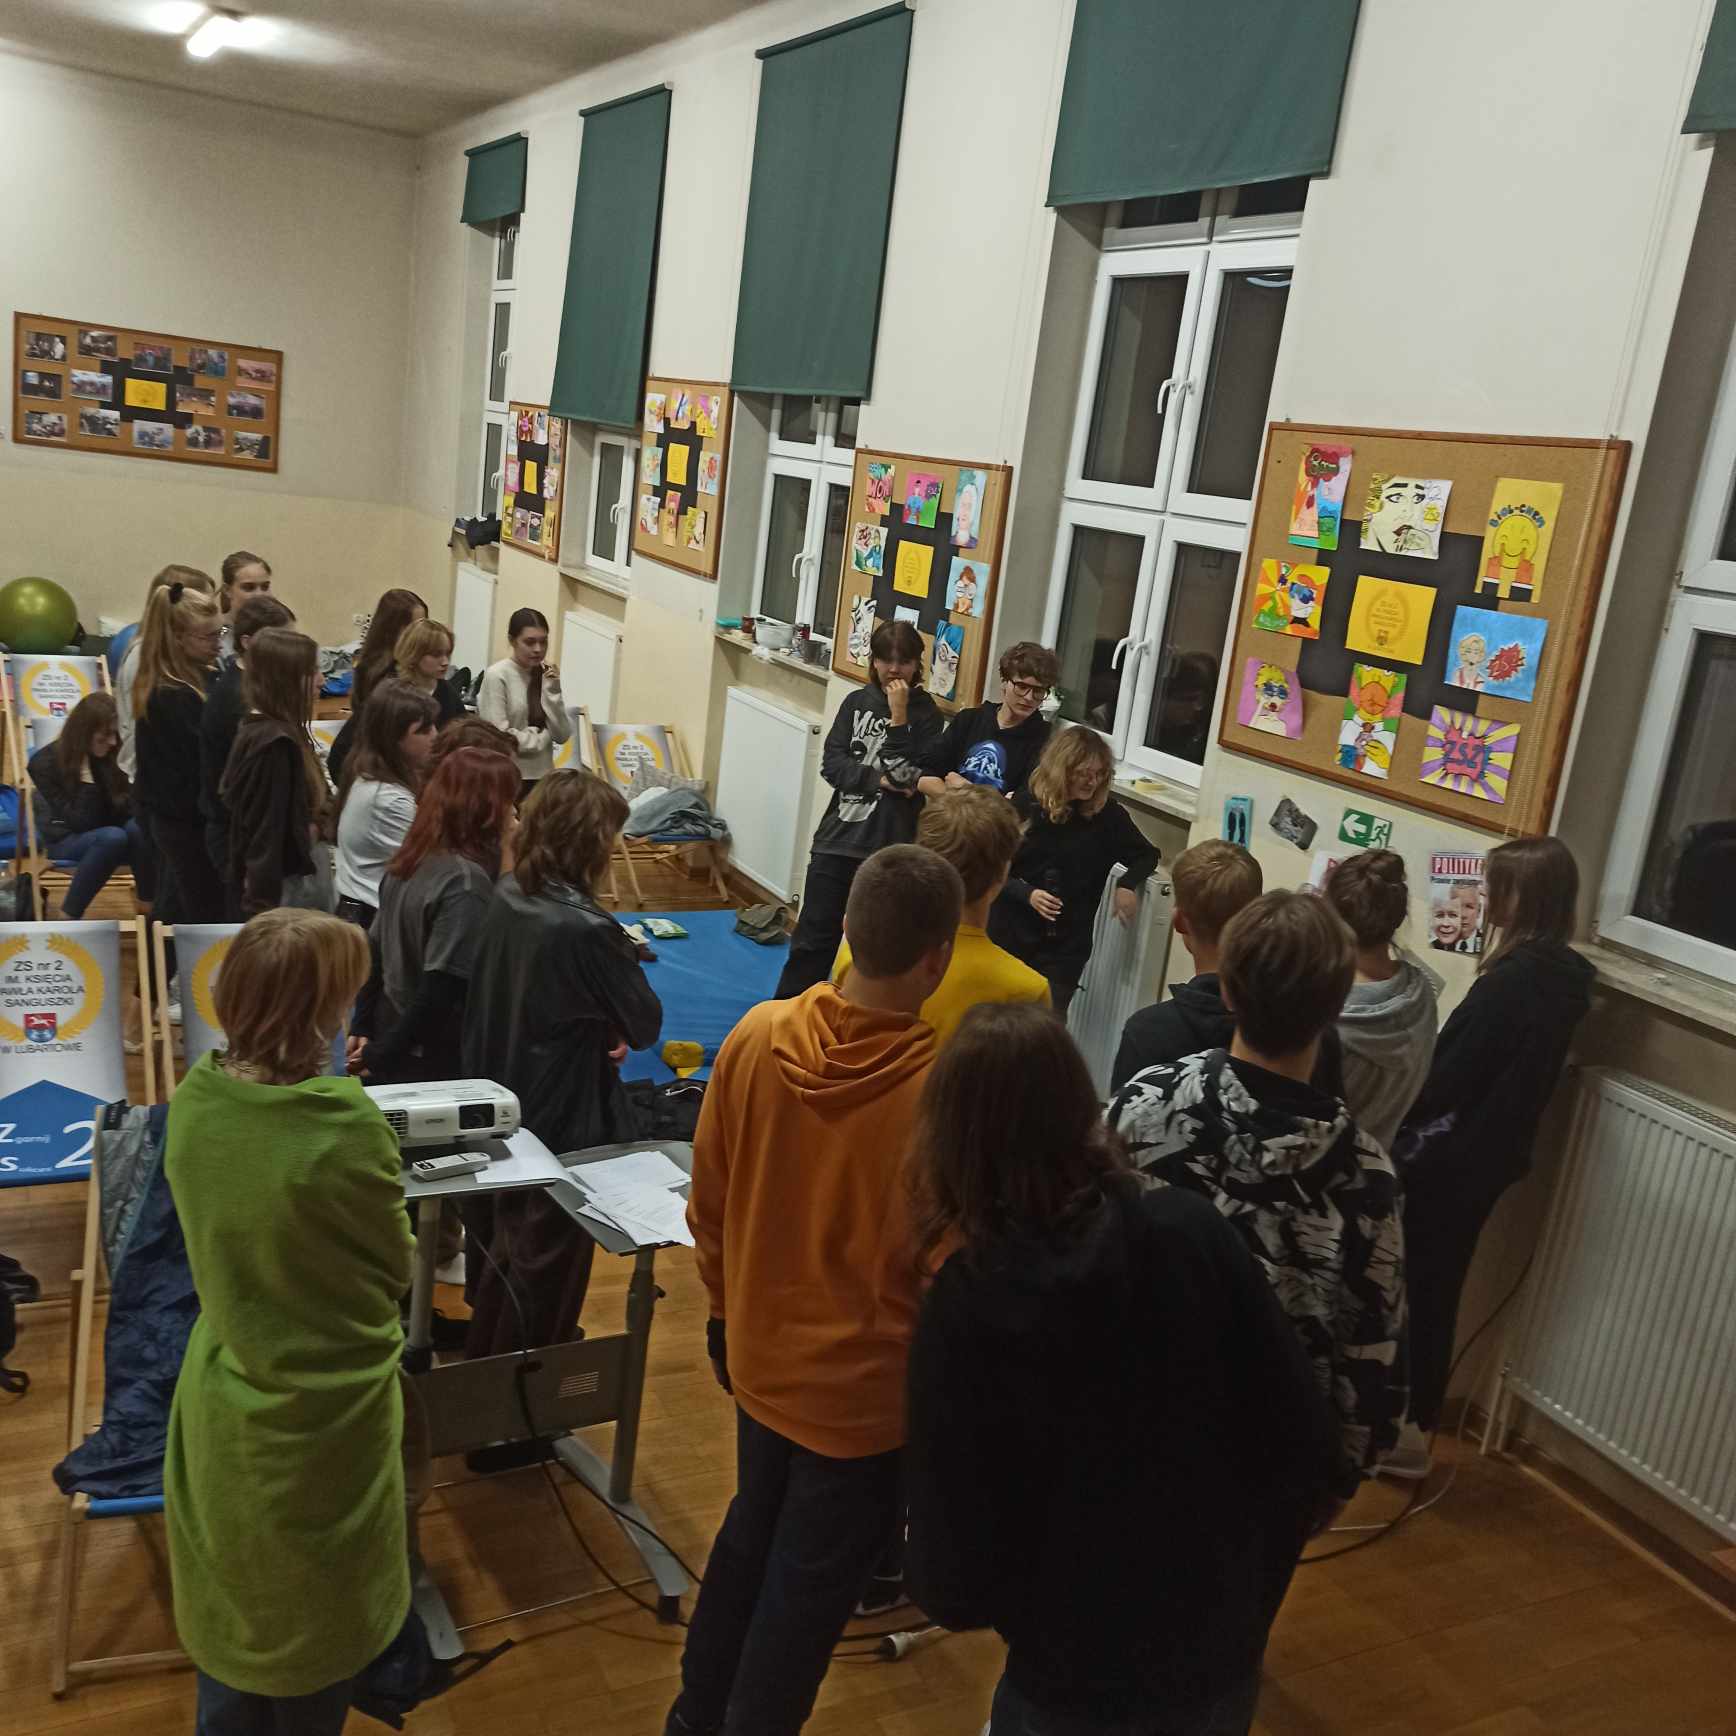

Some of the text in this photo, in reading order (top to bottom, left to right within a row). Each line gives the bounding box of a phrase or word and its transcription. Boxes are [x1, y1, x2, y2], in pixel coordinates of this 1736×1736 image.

[13, 959, 64, 972] ZS nr 2
[36, 985, 86, 995] KAROLA
[54, 1120, 96, 1169] 2
